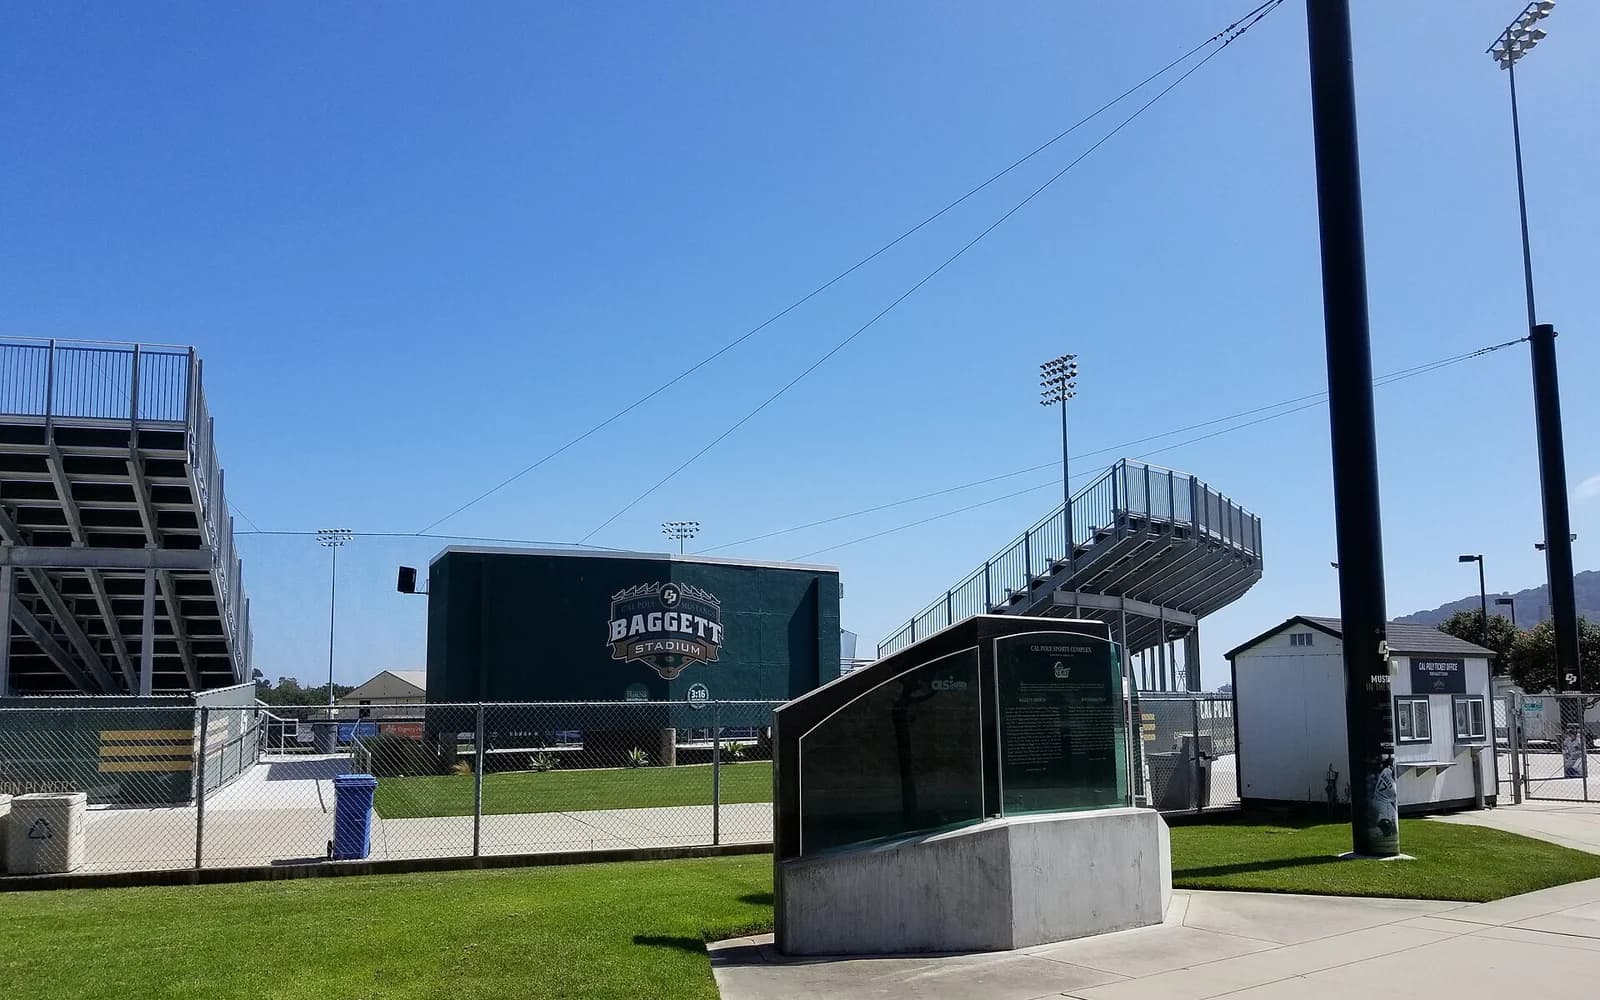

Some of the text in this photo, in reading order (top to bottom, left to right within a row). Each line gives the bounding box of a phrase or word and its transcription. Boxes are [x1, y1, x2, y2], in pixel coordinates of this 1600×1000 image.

[611, 612, 722, 644] BAGGETT
[635, 641, 700, 656] STADIUM
[1418, 662, 1426, 671] CAL
[25, 780, 77, 794] PLAYERS
